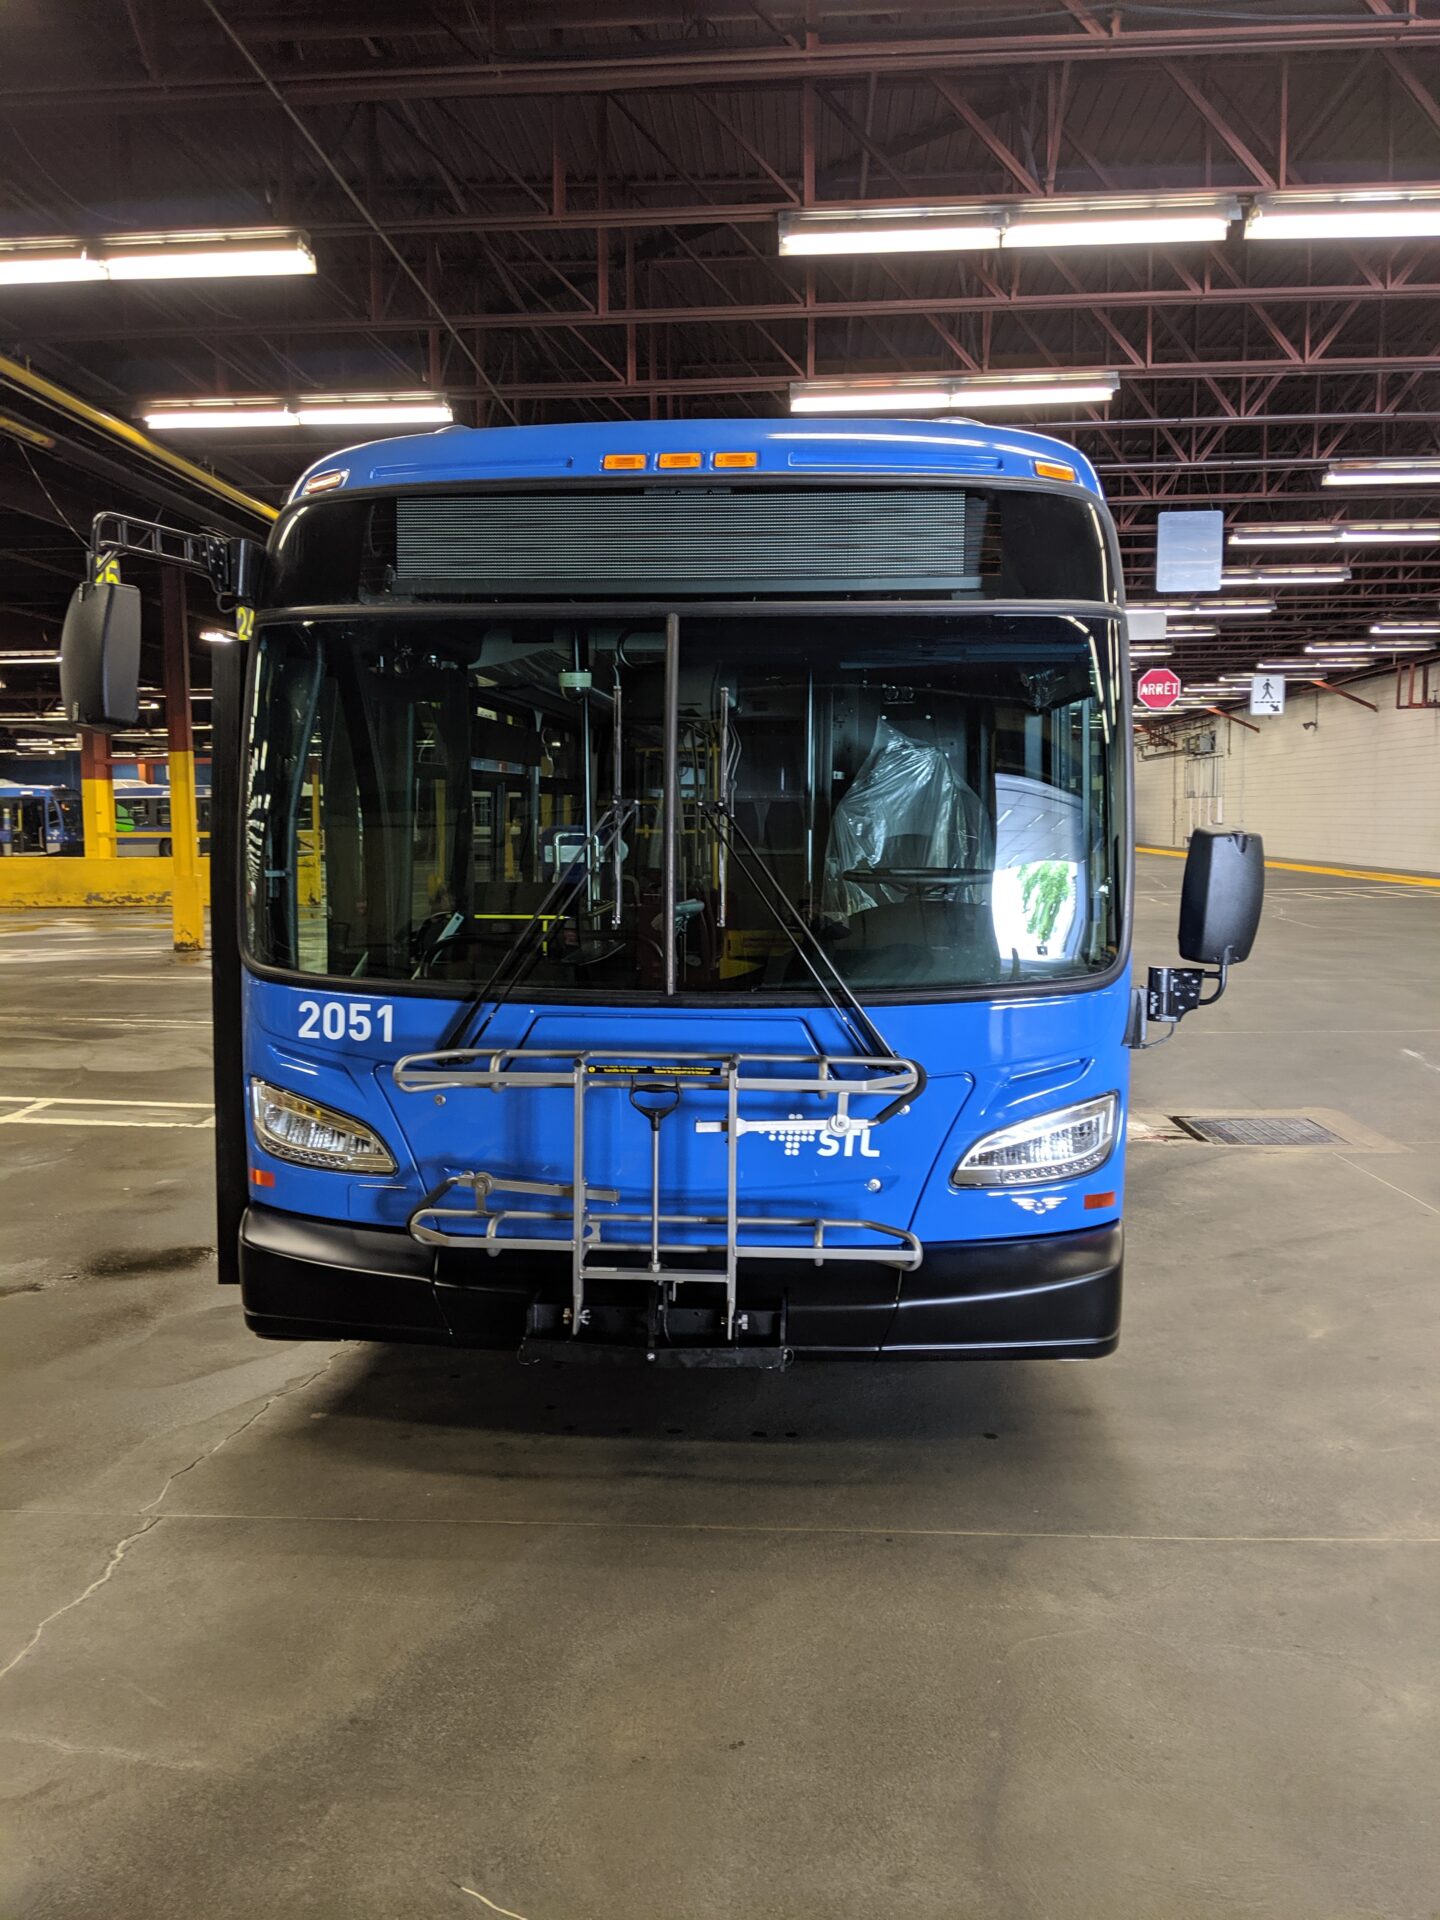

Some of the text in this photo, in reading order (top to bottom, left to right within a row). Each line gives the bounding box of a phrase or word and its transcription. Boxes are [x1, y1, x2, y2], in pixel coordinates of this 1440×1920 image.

[1140, 680, 1178, 696] ARRÊT
[298, 1000, 393, 1043] 2051
[816, 1128, 881, 1158] STL
